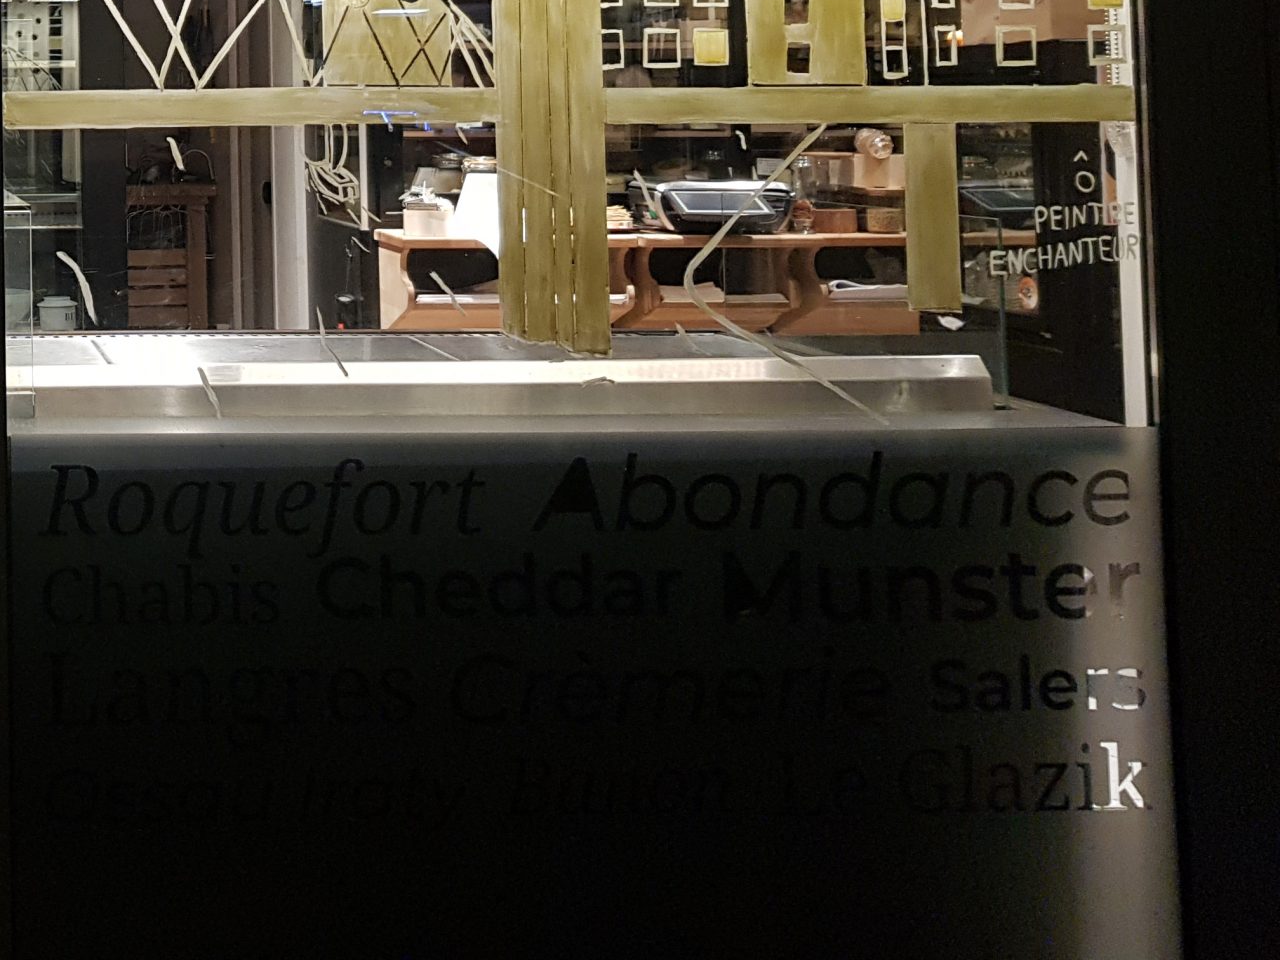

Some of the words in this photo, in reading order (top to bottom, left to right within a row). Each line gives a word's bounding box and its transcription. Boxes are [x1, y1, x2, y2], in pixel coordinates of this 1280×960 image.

[989, 232, 1140, 277] ENCHANTEUR
[1034, 201, 1136, 234] PEINTRE
[37, 457, 487, 559] Roquefort
[531, 450, 1132, 533] Abondance
[41, 562, 281, 627] Chabis
[317, 550, 684, 621] Cheddar
[722, 550, 1142, 624] Munster
[43, 650, 418, 753] Langres
[928, 653, 1146, 713] Salers
[898, 741, 1153, 814] Glazik
